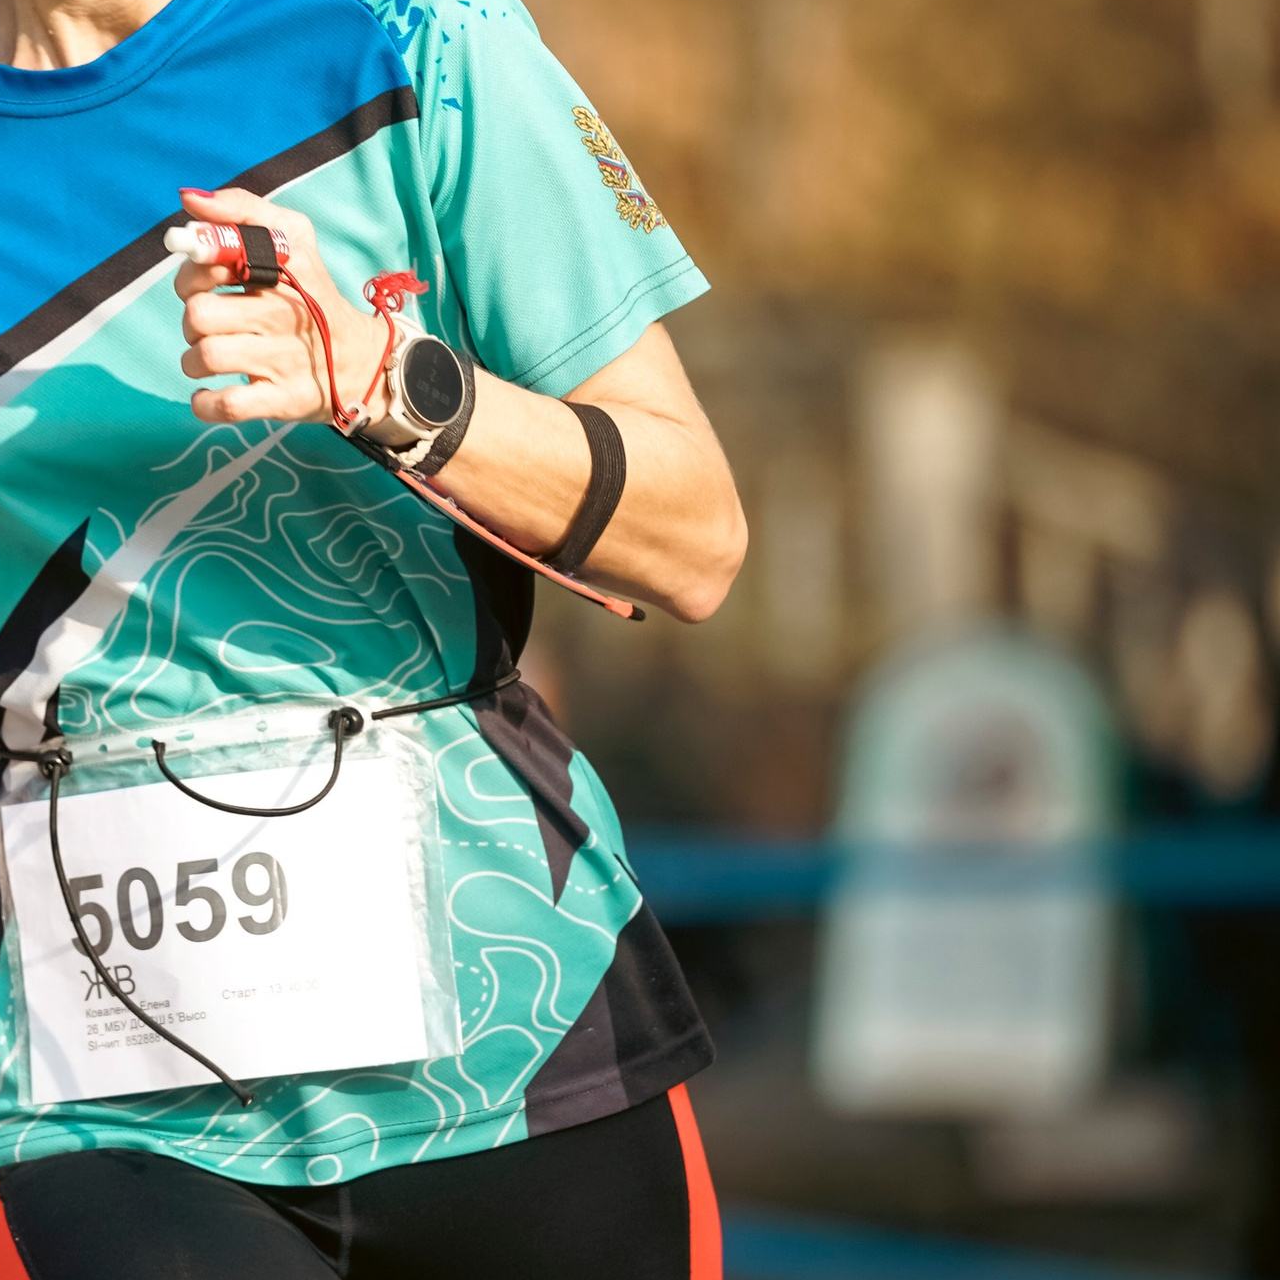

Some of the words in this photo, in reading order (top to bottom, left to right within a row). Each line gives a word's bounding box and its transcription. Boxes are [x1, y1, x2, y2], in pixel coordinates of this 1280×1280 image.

[69, 852, 288, 958] 5059
[81, 965, 136, 1001] ЖВ
[85, 1005, 138, 1019] Ковален
[139, 999, 171, 1011] Елена
